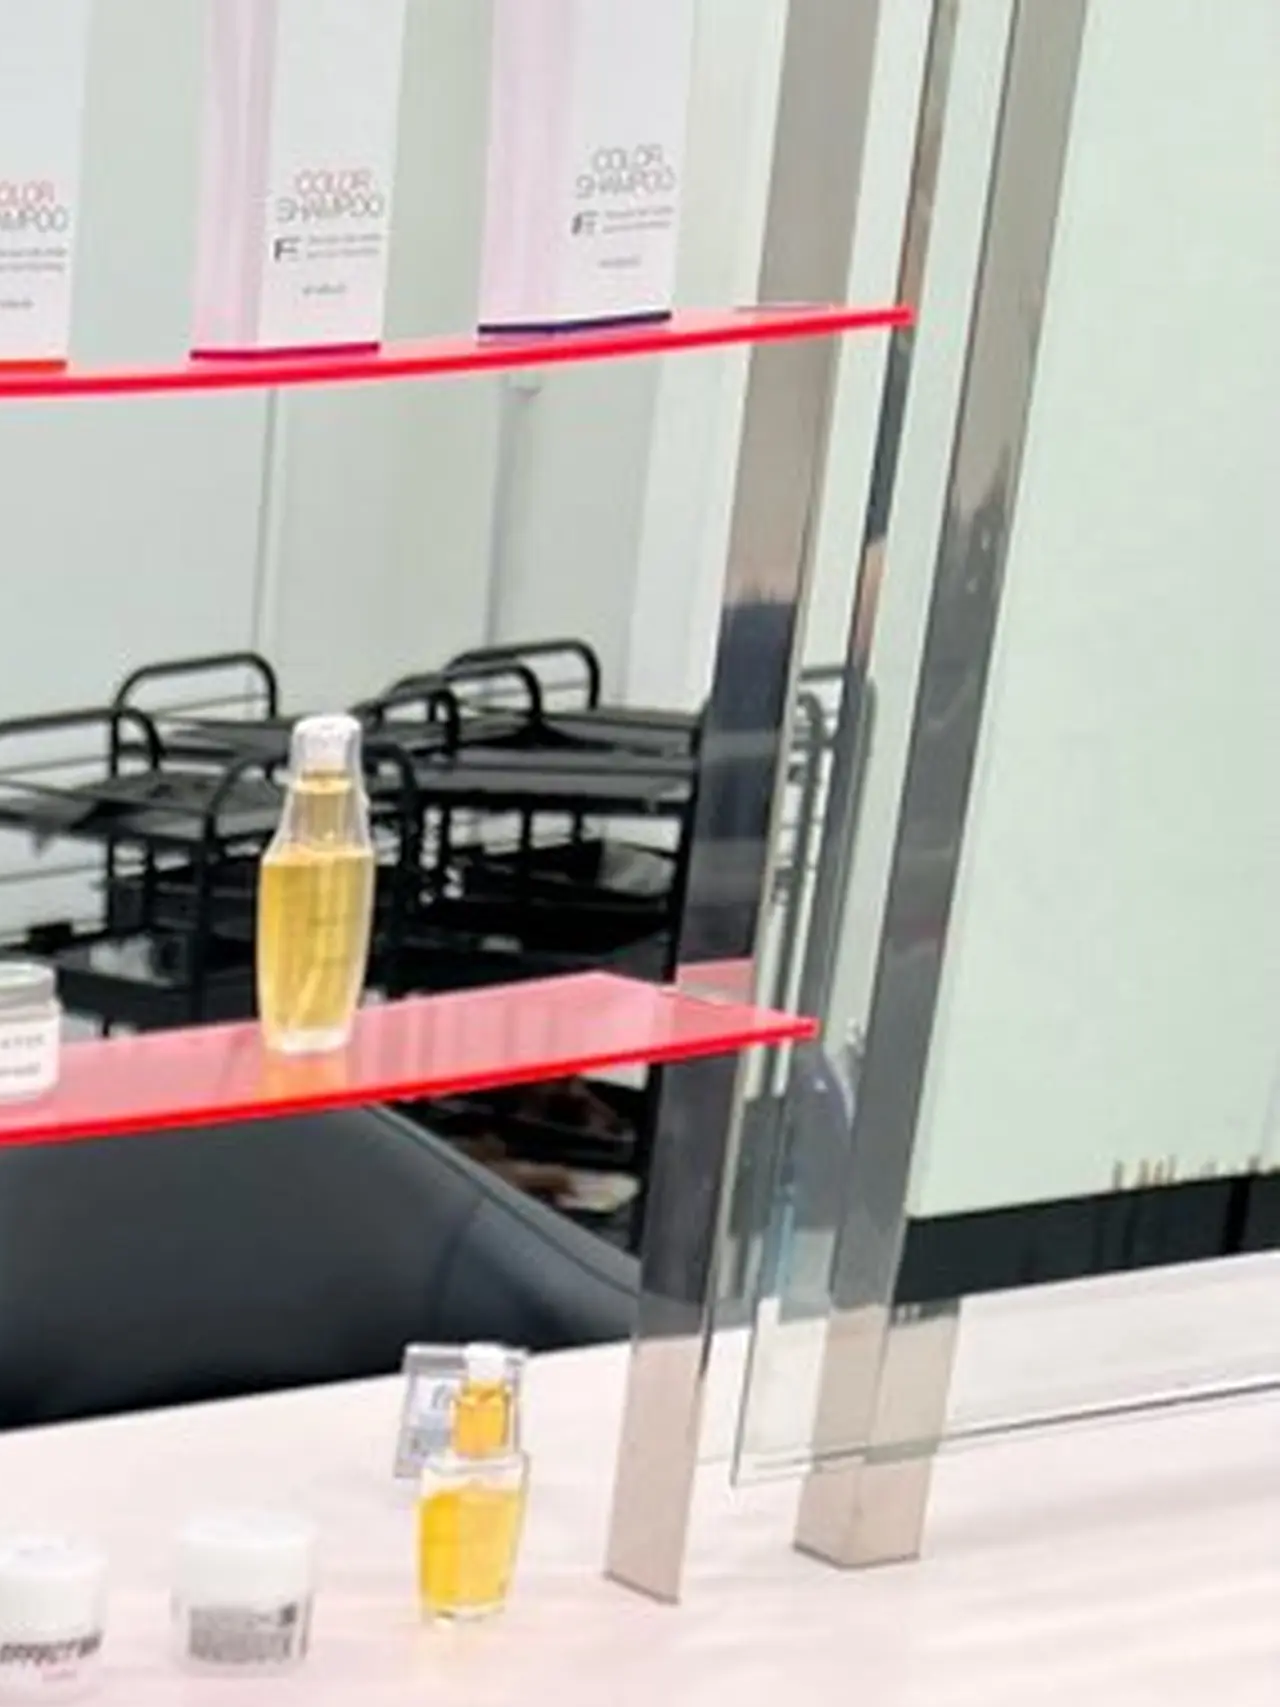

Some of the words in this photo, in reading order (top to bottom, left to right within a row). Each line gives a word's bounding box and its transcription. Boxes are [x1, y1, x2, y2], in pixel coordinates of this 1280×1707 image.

[591, 144, 663, 173] COLOR
[295, 169, 374, 199] COLOR
[575, 165, 676, 199] SHAMPOO
[276, 194, 386, 223] SHAMPOO
